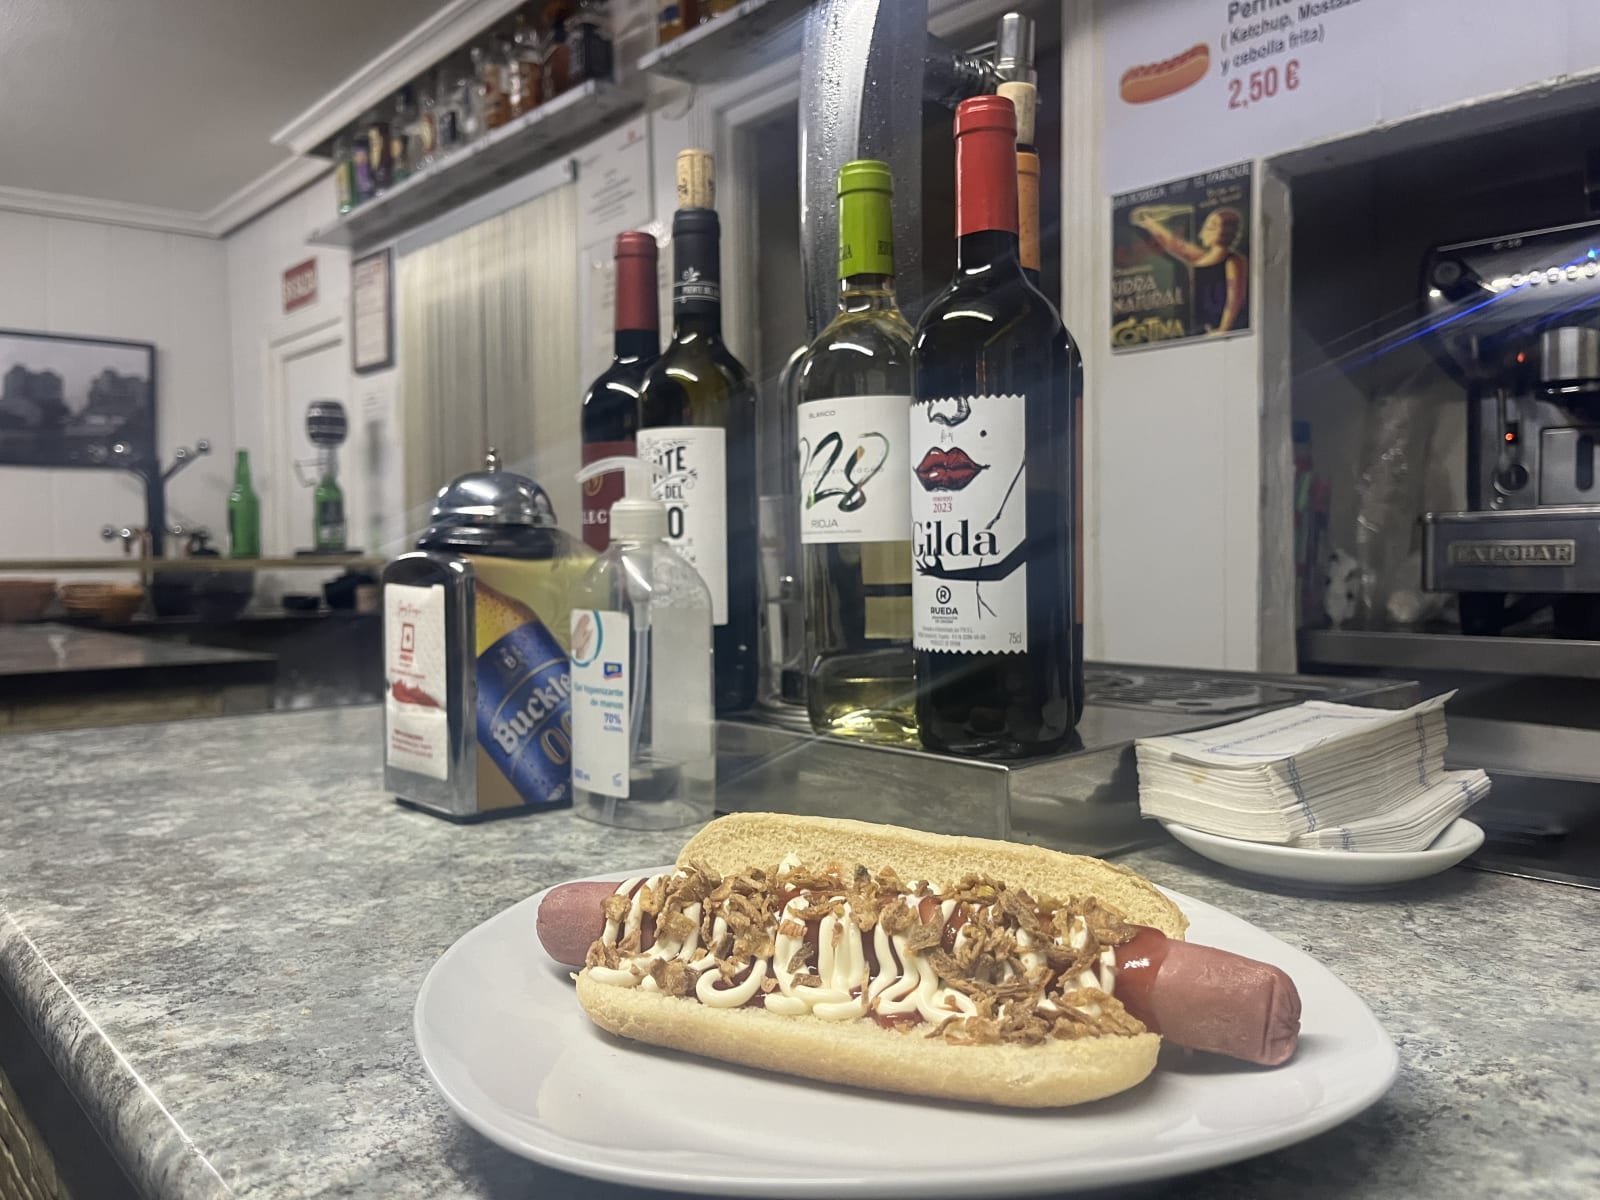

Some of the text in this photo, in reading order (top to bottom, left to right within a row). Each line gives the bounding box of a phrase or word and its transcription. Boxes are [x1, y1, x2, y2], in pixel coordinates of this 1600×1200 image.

[1220, 59, 1230, 76] y
[1232, 40, 1284, 67] cebolla
[1228, 59, 1301, 110] 2,50 €
[665, 485, 684, 500] DEL
[933, 502, 953, 513] 2023
[811, 519, 839, 529] RIOJA
[912, 518, 1000, 558] Gilda
[930, 606, 959, 616] RUEDA
[1008, 631, 1022, 644] 75cl
[493, 672, 571, 756] Buckle
[603, 712, 622, 725] 70%
